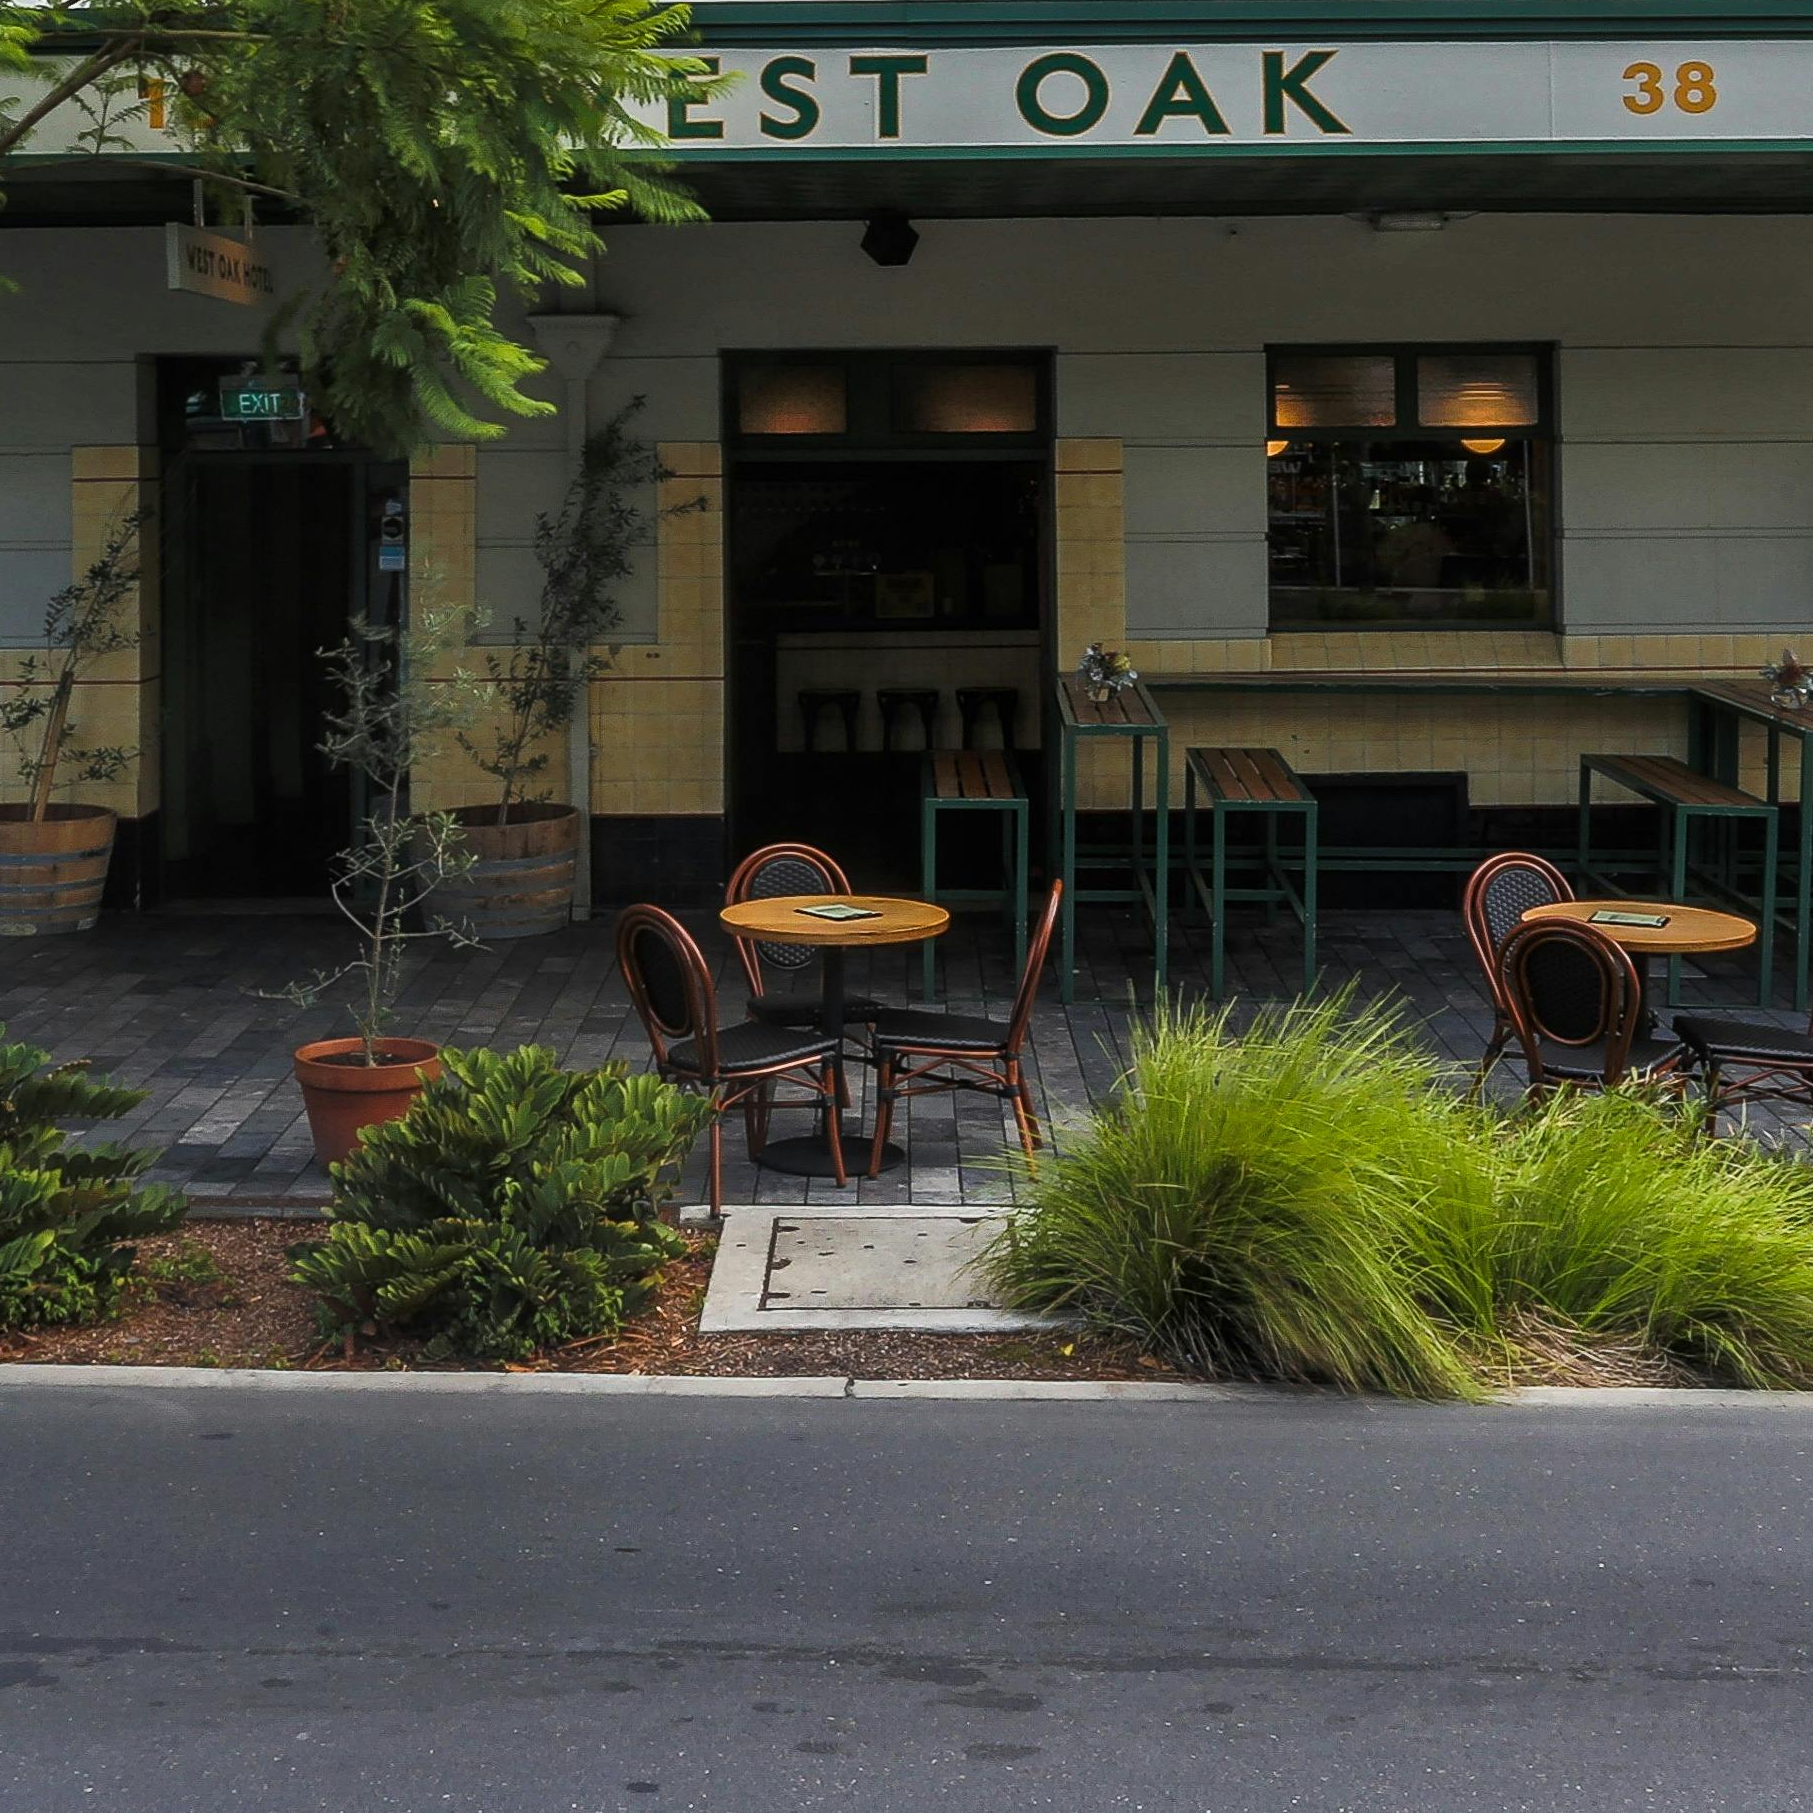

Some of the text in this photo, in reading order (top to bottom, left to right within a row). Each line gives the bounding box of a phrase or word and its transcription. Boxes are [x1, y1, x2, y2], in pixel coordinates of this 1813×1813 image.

[667, 49, 1354, 140] EST OAK
[1622, 61, 1719, 116] 38
[186, 243, 215, 276] WEST
[218, 254, 241, 284] OAK
[238, 393, 281, 414] EXIT
